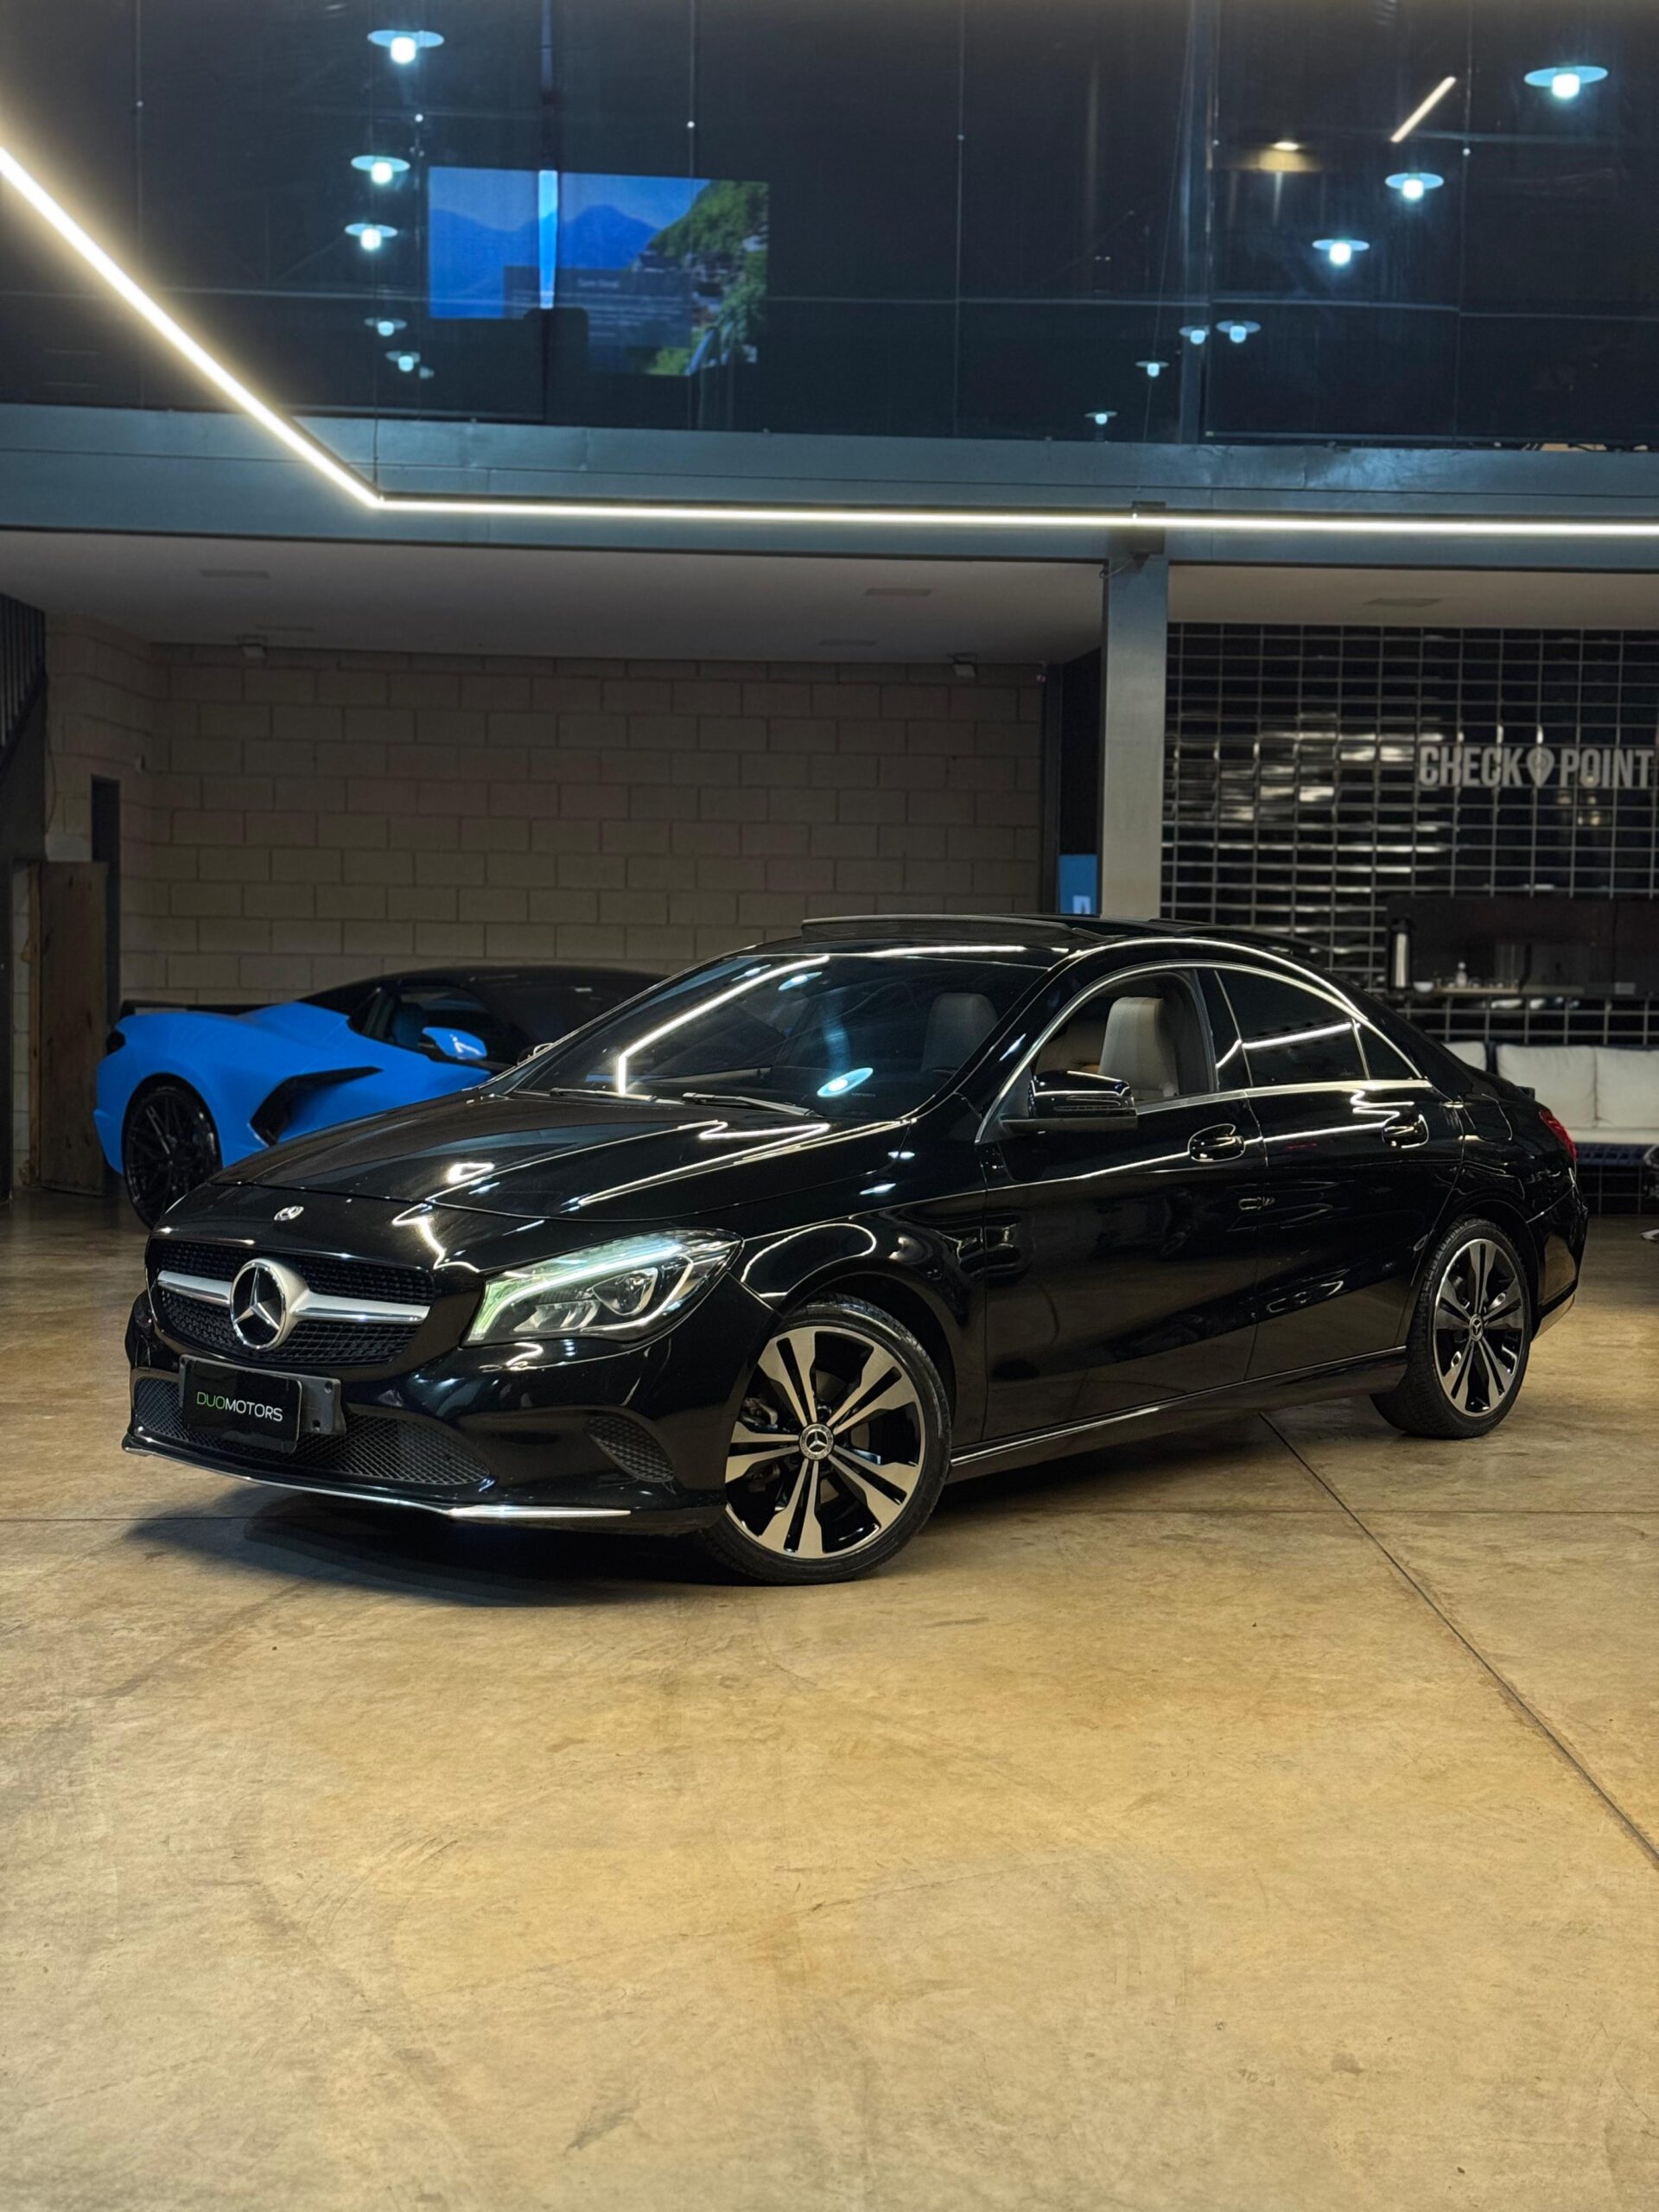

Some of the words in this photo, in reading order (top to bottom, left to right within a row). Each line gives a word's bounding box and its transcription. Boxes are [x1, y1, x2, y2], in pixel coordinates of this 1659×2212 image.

[1419, 747, 1524, 787] CHECK
[1560, 748, 1655, 789] POINT
[196, 1391, 283, 1421] DUOMOTORS
